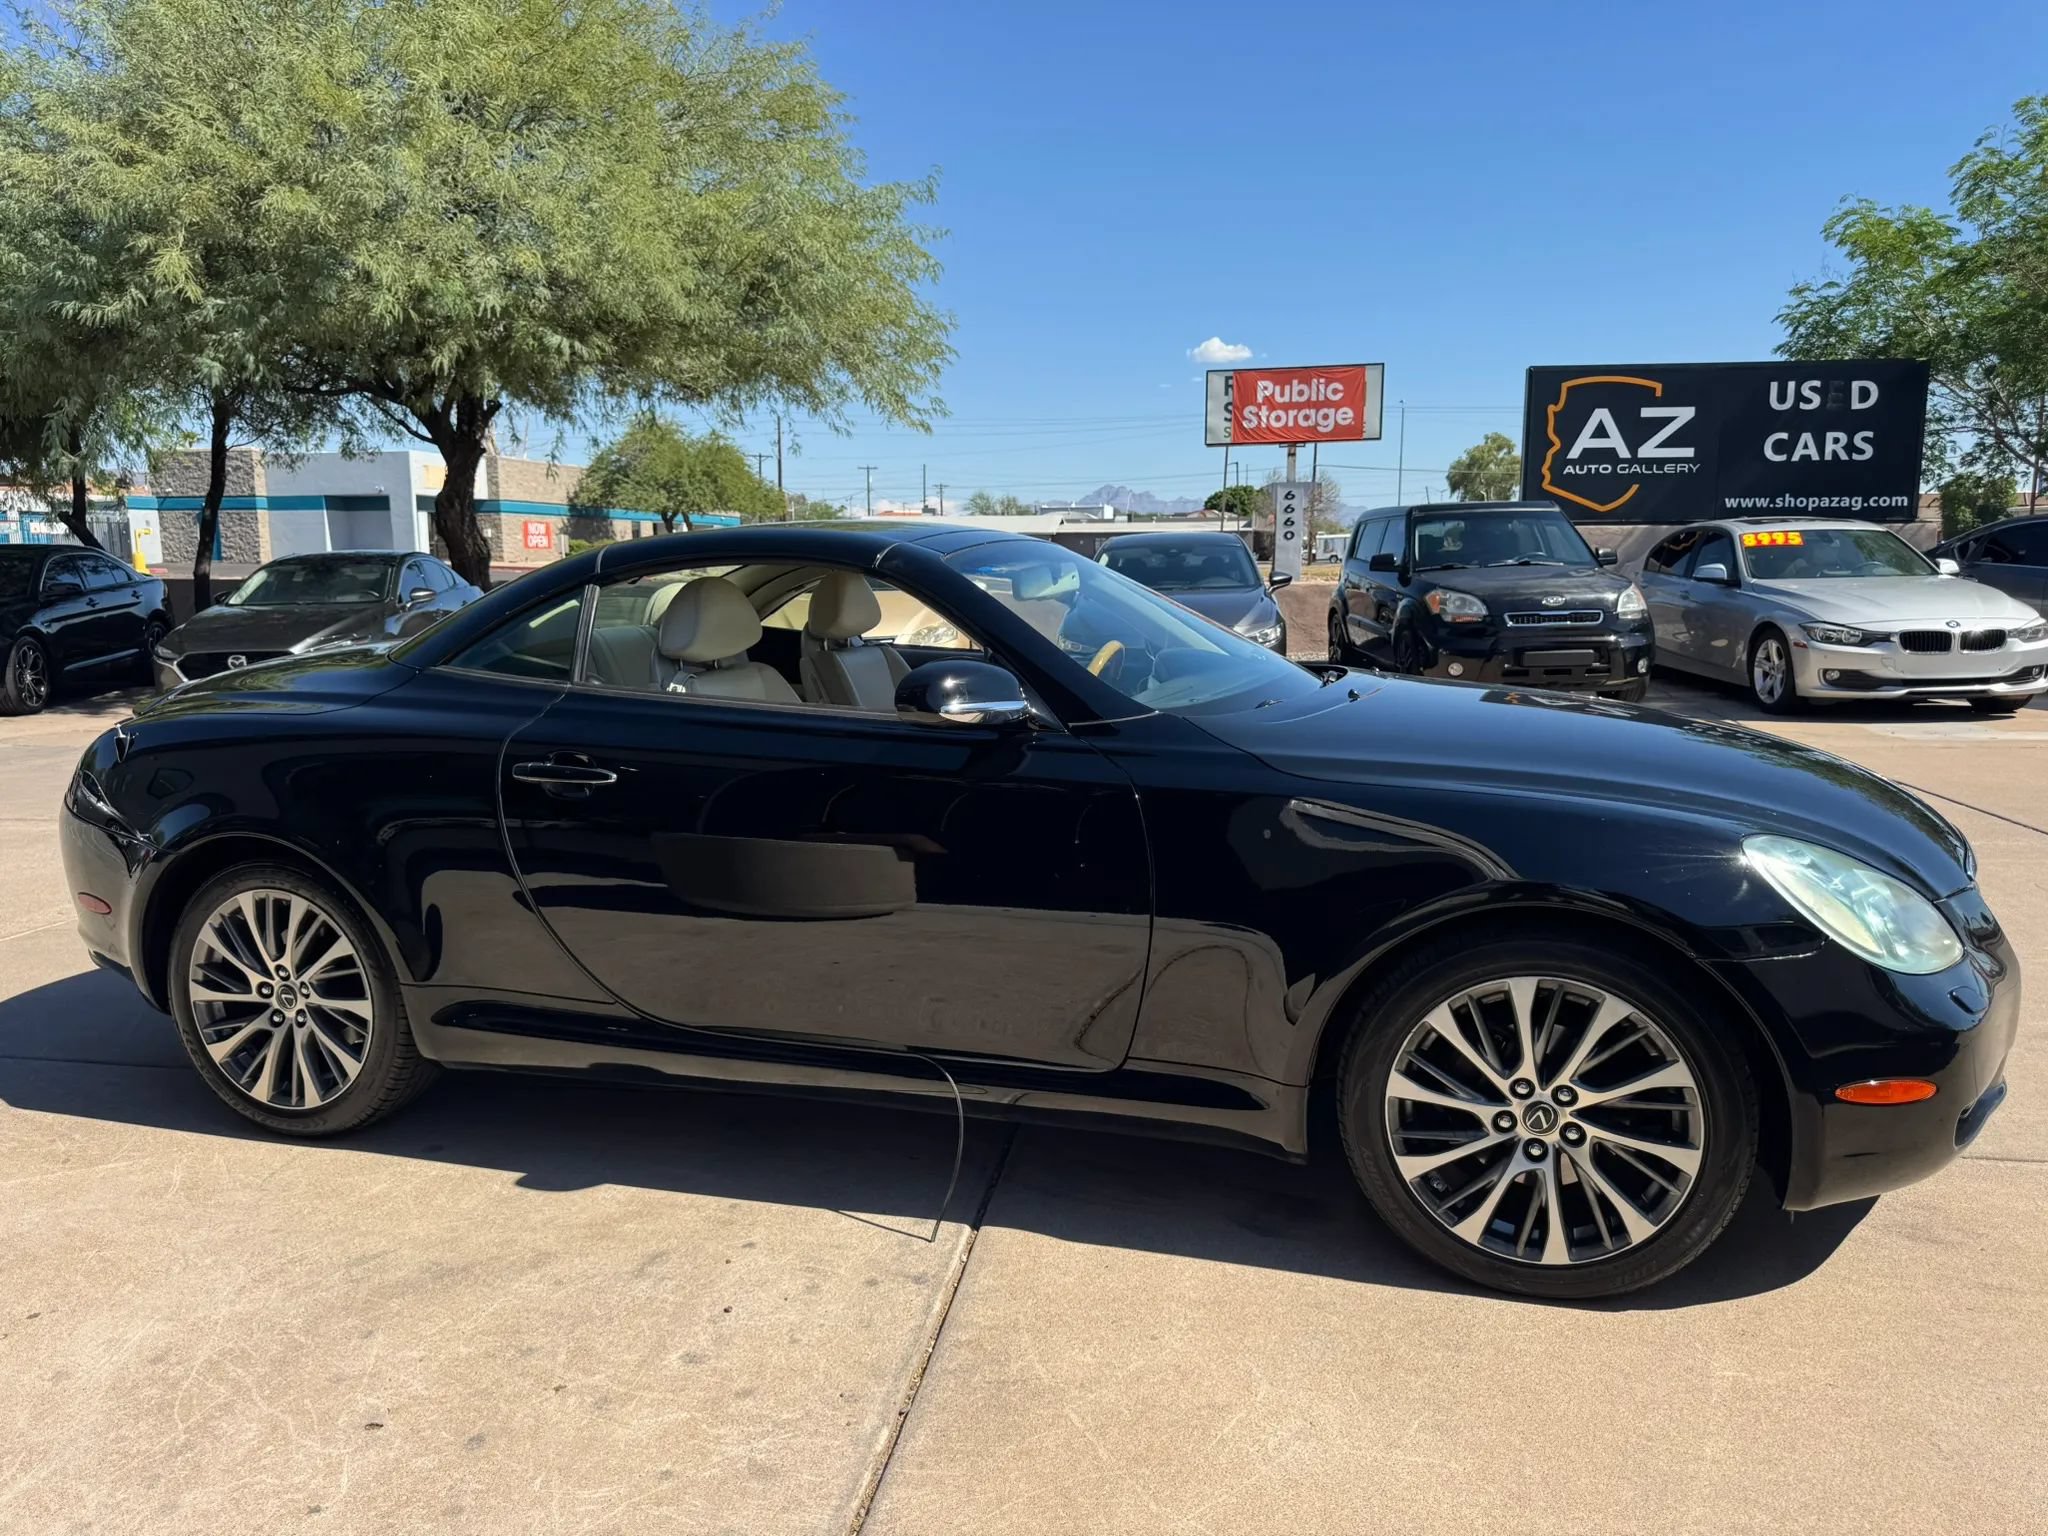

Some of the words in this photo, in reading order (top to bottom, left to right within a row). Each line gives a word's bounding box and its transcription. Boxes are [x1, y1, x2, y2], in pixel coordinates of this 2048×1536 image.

[1257, 379, 1344, 403] Public
[1566, 406, 1696, 459] AZ
[1763, 430, 1874, 462] CARS
[1563, 464, 1611, 475] AUTO
[1616, 463, 1701, 474] GALLERY
[1724, 493, 1909, 512] www.shopazag.com
[1284, 490, 1296, 541] 6660
[527, 522, 547, 535] NOW
[527, 535, 549, 548] OPEN
[1742, 531, 1803, 546] 8995
